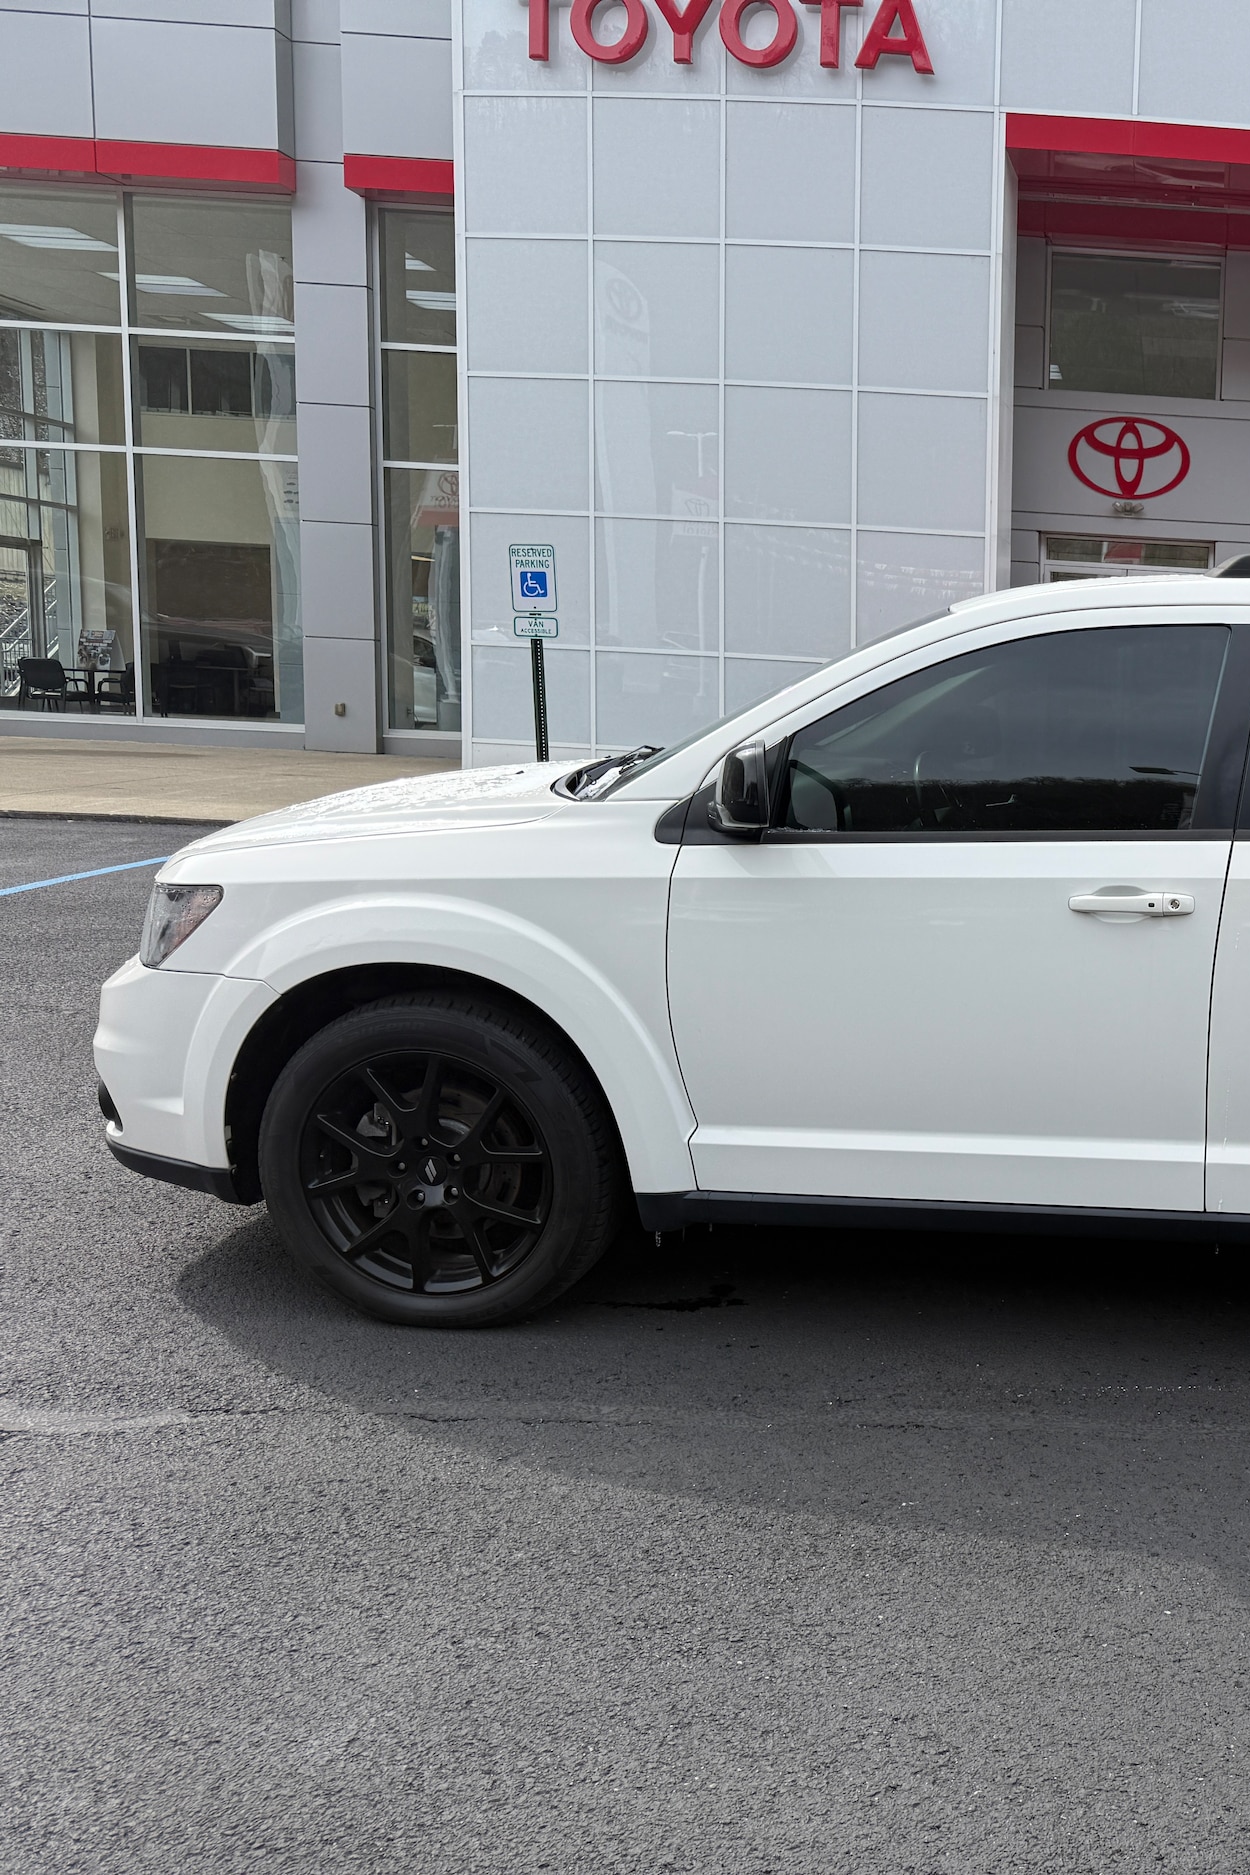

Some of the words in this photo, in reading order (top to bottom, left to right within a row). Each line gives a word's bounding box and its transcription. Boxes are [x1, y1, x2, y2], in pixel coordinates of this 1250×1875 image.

[527, 0, 935, 75] TOYOTA
[511, 548, 552, 557] RESERVED
[515, 559, 550, 568] PARKING
[528, 620, 544, 628] VAN
